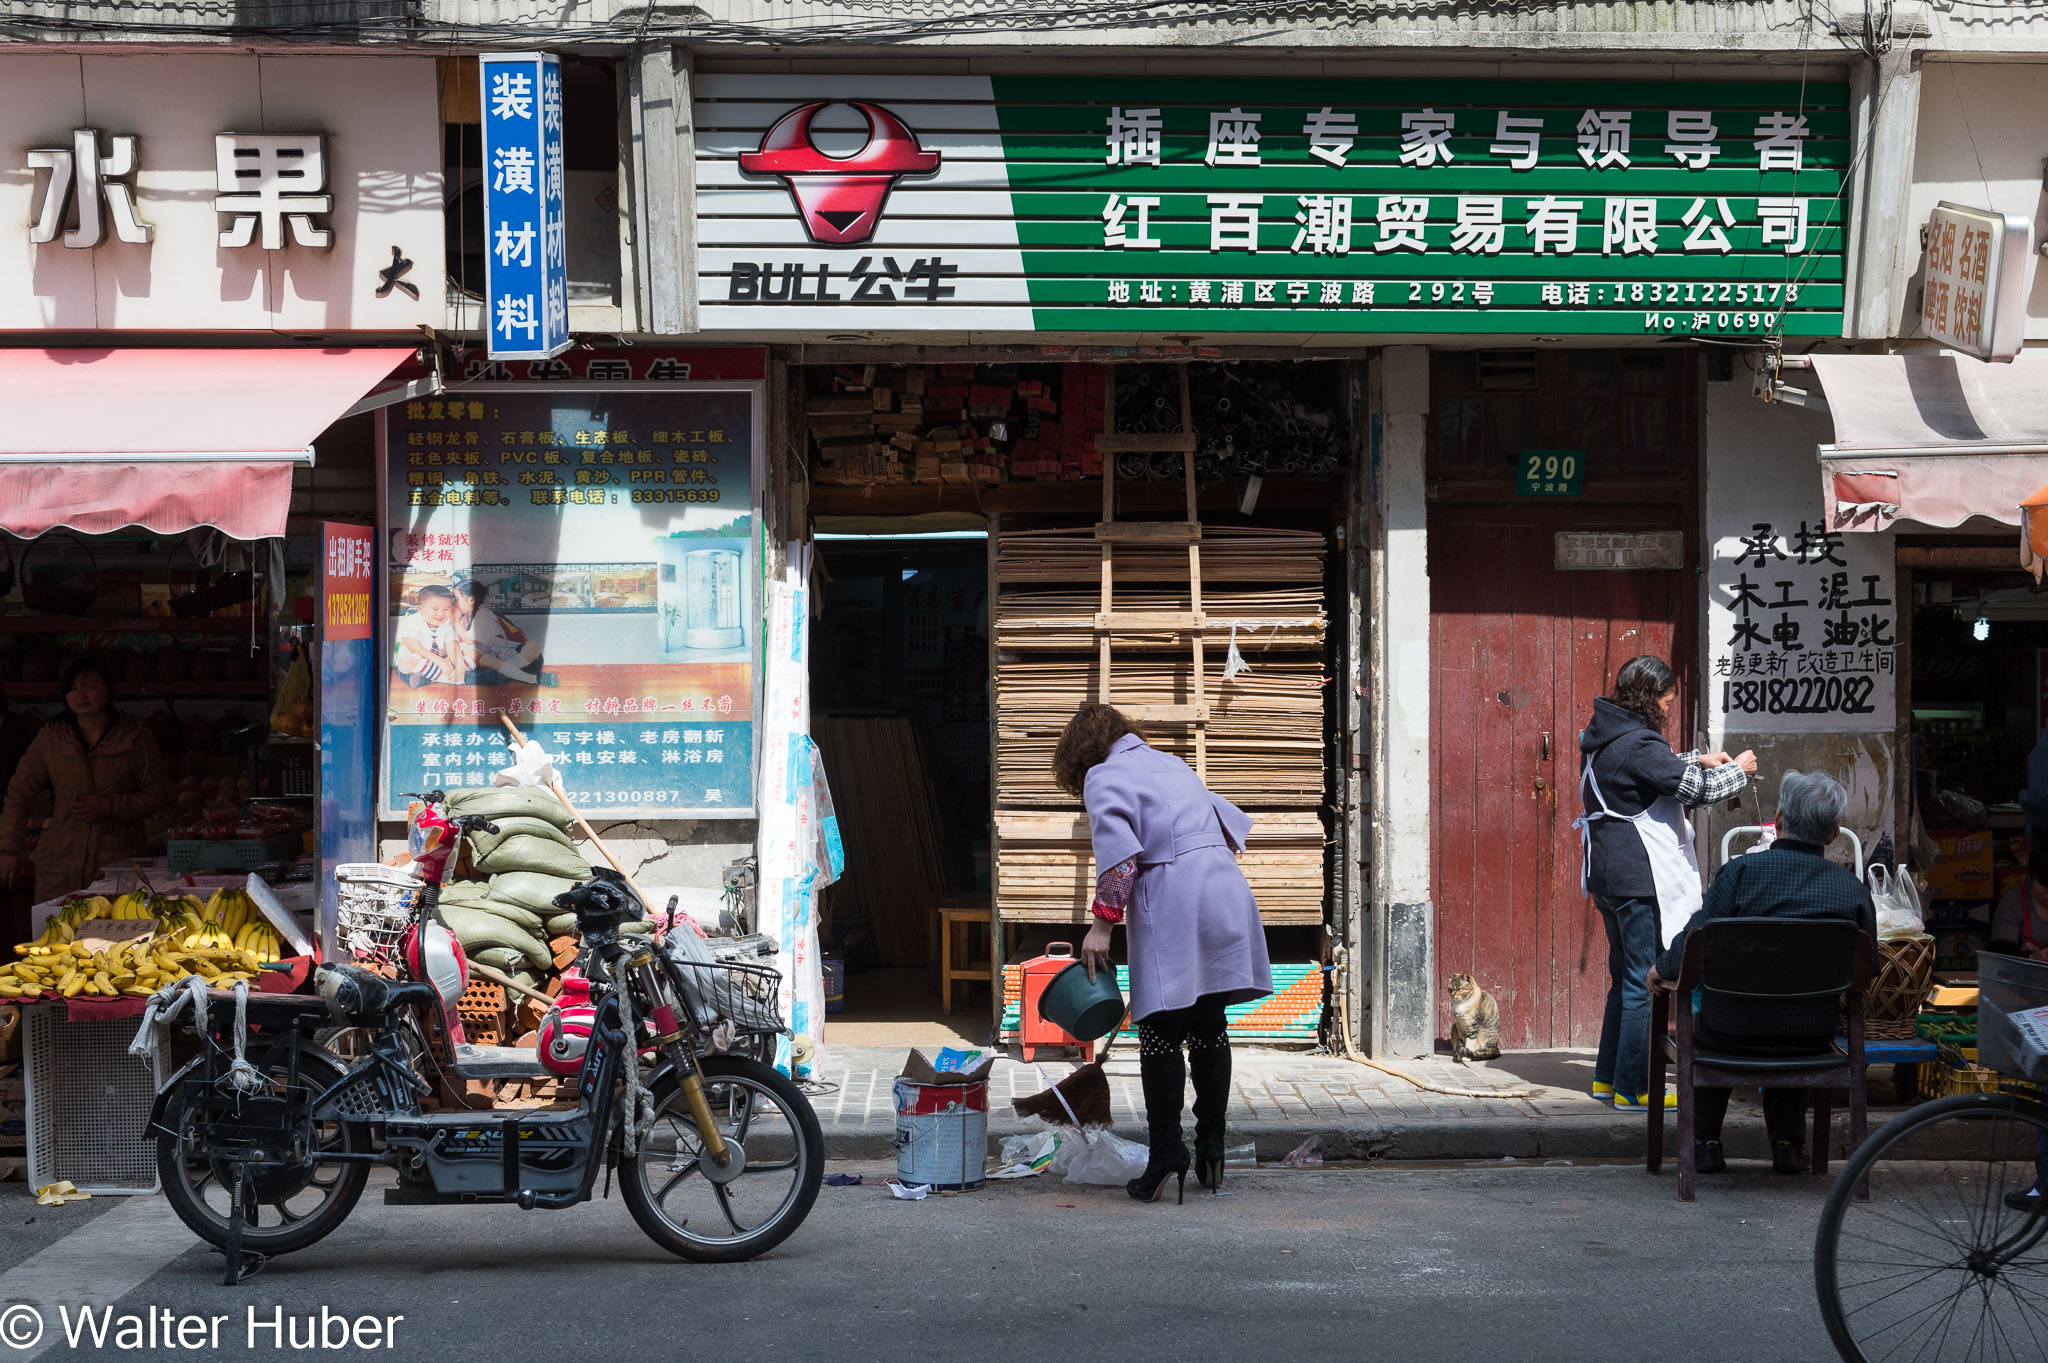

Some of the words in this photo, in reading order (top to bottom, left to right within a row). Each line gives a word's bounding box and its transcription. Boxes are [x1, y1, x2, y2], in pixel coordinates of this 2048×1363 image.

[1104, 107, 1810, 172] 插座专家与领导者
[27, 128, 333, 250] 水果
[491, 73, 539, 341] 装潢材料
[544, 73, 565, 338] 装潢材料
[1101, 193, 1810, 255] 红百潮贸易有限公司
[375, 245, 420, 301] 大
[729, 262, 843, 301] BULL
[847, 256, 959, 301] 公牛
[1408, 281, 1496, 305] 292号
[1527, 456, 1576, 480] 290
[1531, 483, 1569, 492] 宁波路
[328, 535, 371, 579] 出租脚手架
[405, 533, 470, 547] 装修就找
[405, 548, 454, 562] 吴老板
[1733, 519, 1847, 568] 承接
[328, 592, 370, 626] 13795212097
[1726, 572, 1809, 617] 木工
[1721, 676, 1876, 715] 13818222082
[422, 751, 518, 767] 室内外装
[454, 1130, 534, 1139] BEAUY
